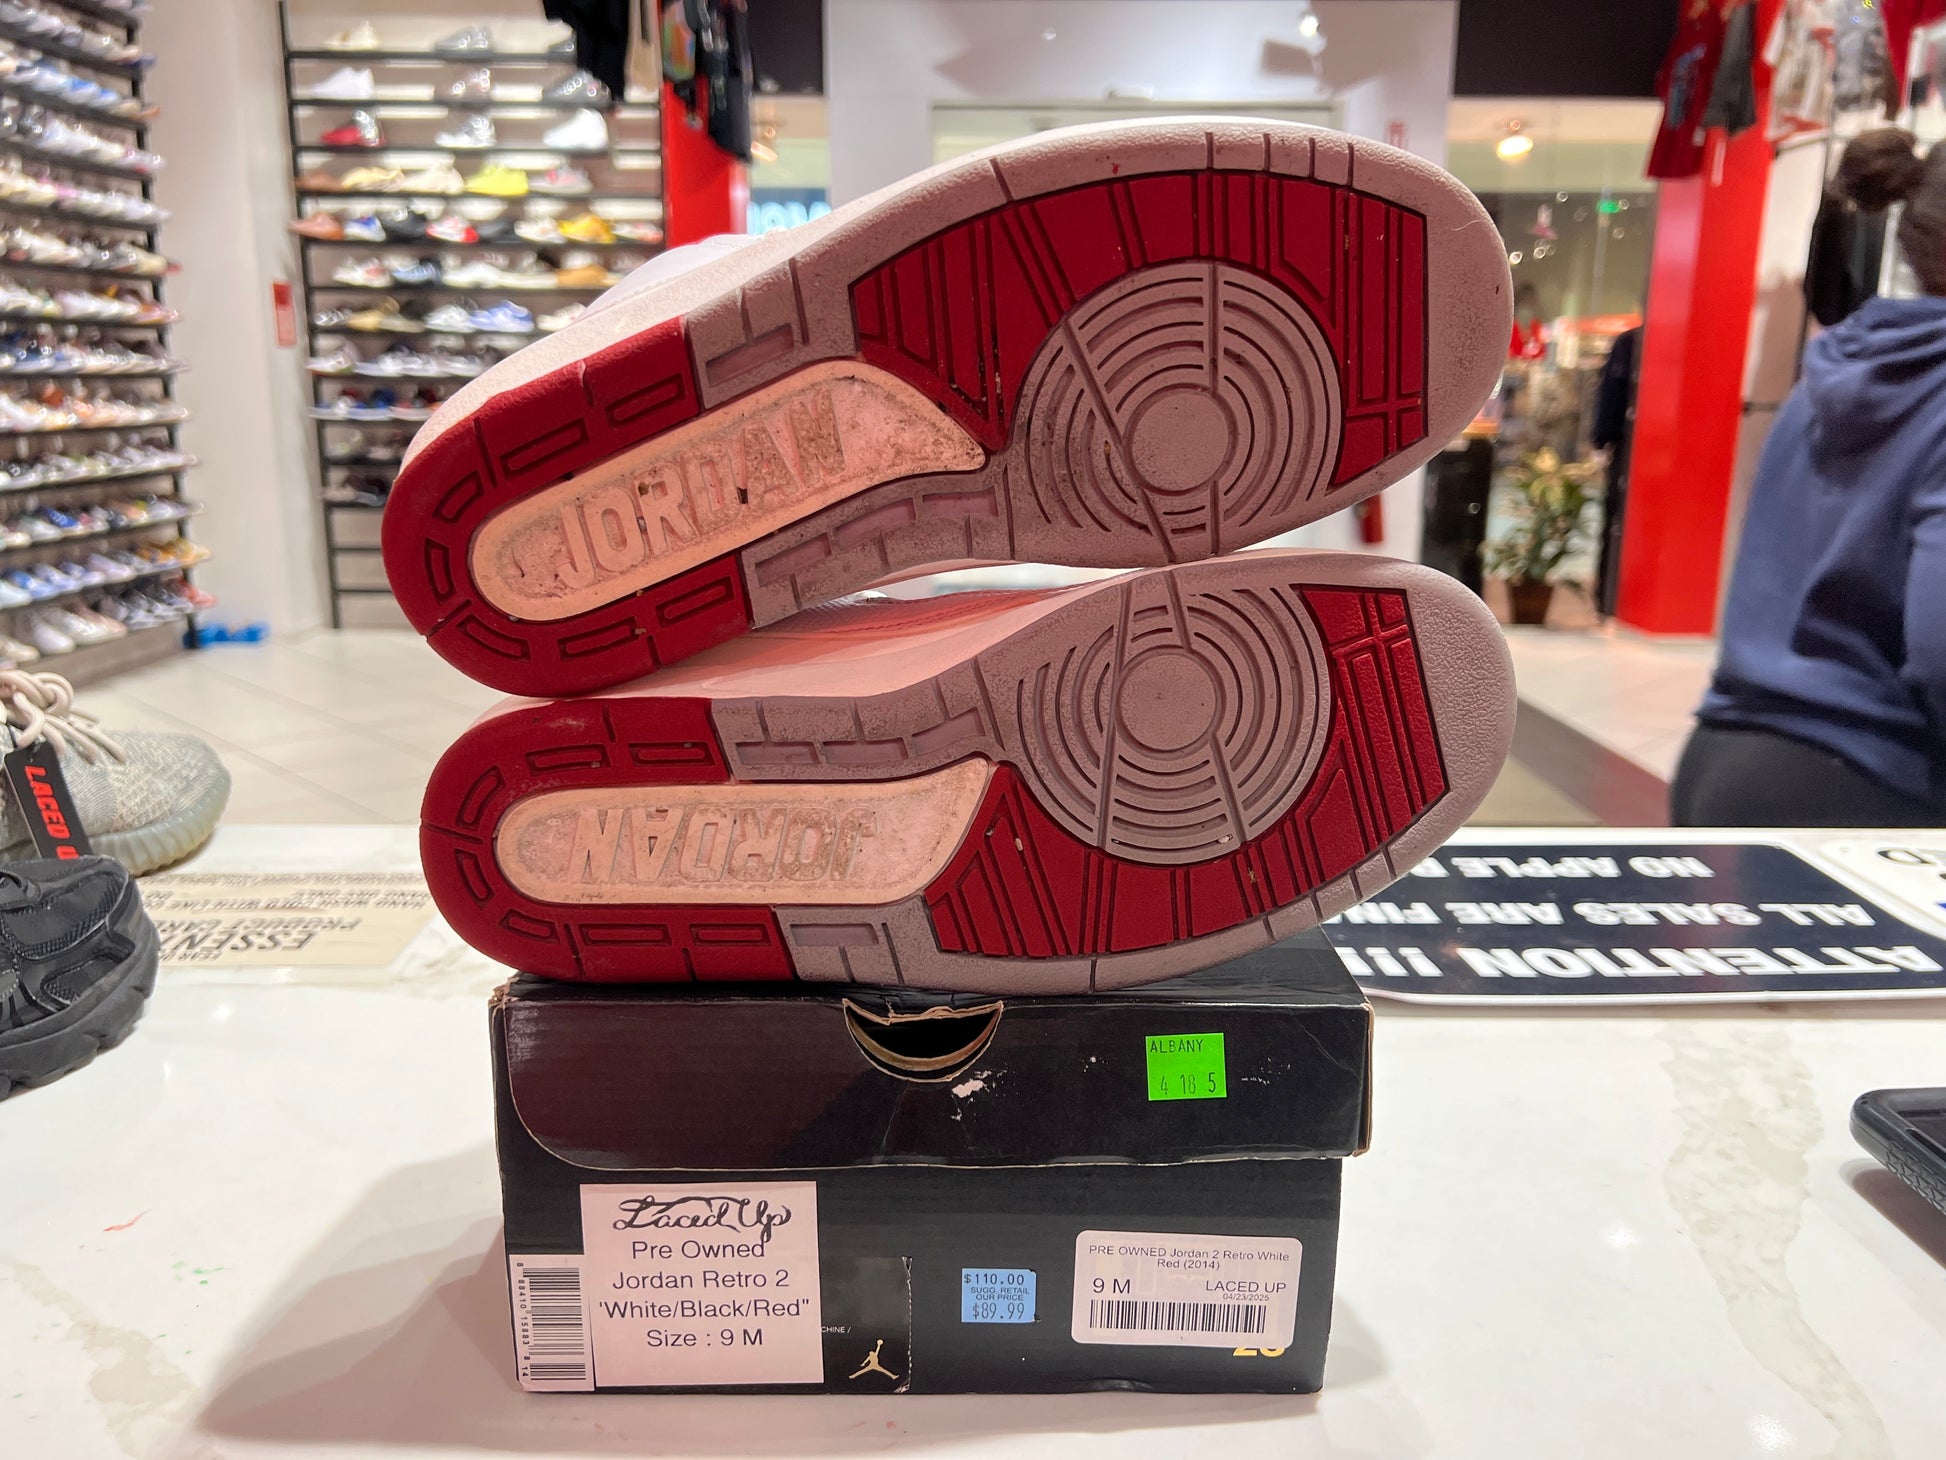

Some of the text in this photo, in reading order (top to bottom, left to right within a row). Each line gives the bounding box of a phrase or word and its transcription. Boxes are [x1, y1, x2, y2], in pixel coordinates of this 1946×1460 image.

[555, 388, 848, 590] JORDAN
[25, 765, 71, 839] LACED
[567, 806, 878, 884] JORDAN
[1450, 856, 1623, 878] APPLE
[1628, 856, 1716, 878] NO
[1322, 902, 1876, 926] ALL SALES ARE FIN
[1456, 946, 1943, 978] ATTENTION
[1150, 1039, 1204, 1054] ALBANY
[1160, 1075, 1169, 1095] 4
[1207, 1071, 1216, 1093] 5
[613, 1195, 792, 1243] Laced Up
[632, 1240, 765, 1259] Pre Owned
[1089, 1245, 1290, 1262] PRE OWNED Jordan 2 Retro White
[1157, 1258, 1221, 1271] Red (2014)
[613, 1269, 790, 1290] Jordan Retro 2
[963, 1273, 1025, 1285] $110.00
[1092, 1277, 1287, 1294] 9 M LACED UP
[1222, 1293, 1271, 1302] 04/23/2025
[973, 1302, 1025, 1319] $89.99
[647, 1329, 697, 1347] Size
[720, 1330, 735, 1346] 9
[743, 1328, 764, 1345] M
